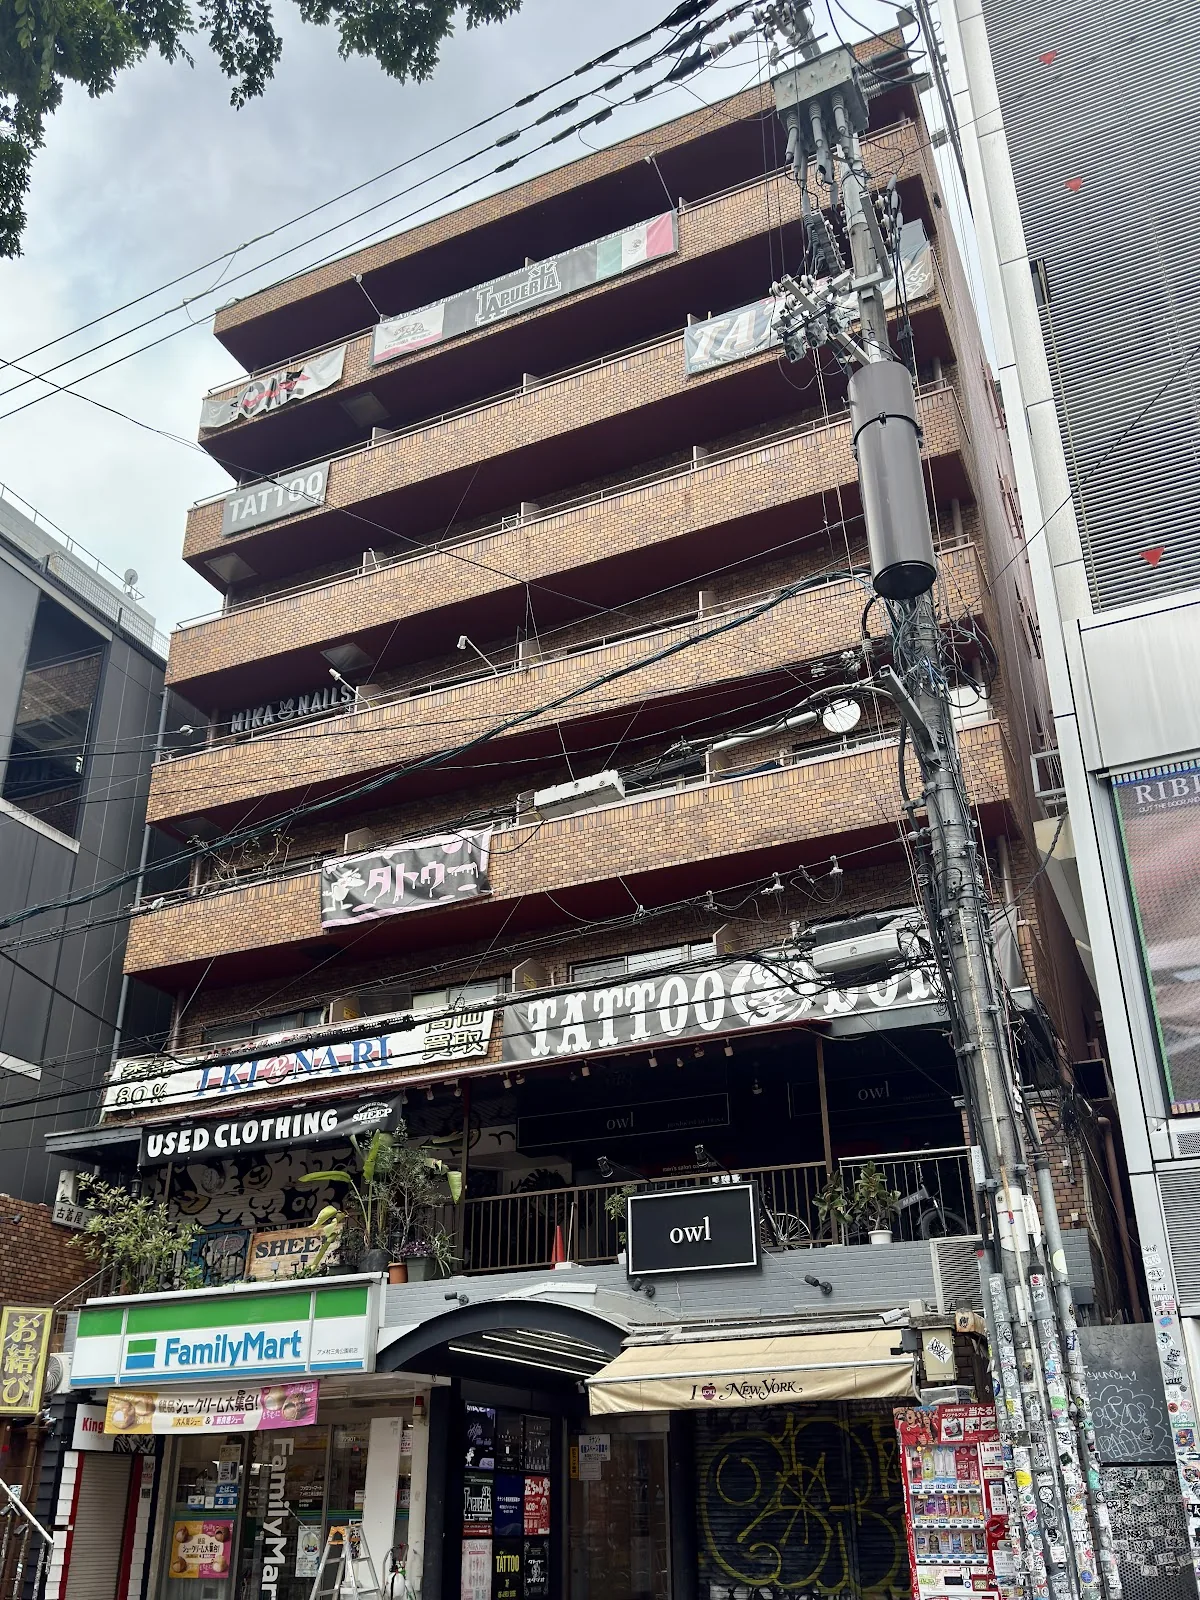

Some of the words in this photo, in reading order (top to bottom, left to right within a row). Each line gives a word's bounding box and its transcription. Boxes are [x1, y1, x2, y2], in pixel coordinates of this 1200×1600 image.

[229, 470, 323, 522] TATTOO
[298, 684, 353, 716] NAILS
[527, 967, 725, 1057] TATTOO
[858, 1080, 890, 1101] owl
[352, 1107, 393, 1122] SHEEP
[606, 1111, 634, 1130] owl
[146, 1127, 210, 1158] USED
[214, 1108, 339, 1149] CLOTHING
[669, 1215, 712, 1244] owl
[256, 1236, 328, 1258] SHEE
[3, 1315, 40, 1403] お結び
[164, 1329, 302, 1367] FamilyMart
[690, 1384, 698, 1400] I
[968, 1406, 996, 1416] 当たる!
[82, 1417, 104, 1434] King
[496, 1554, 520, 1572] TATTOO
